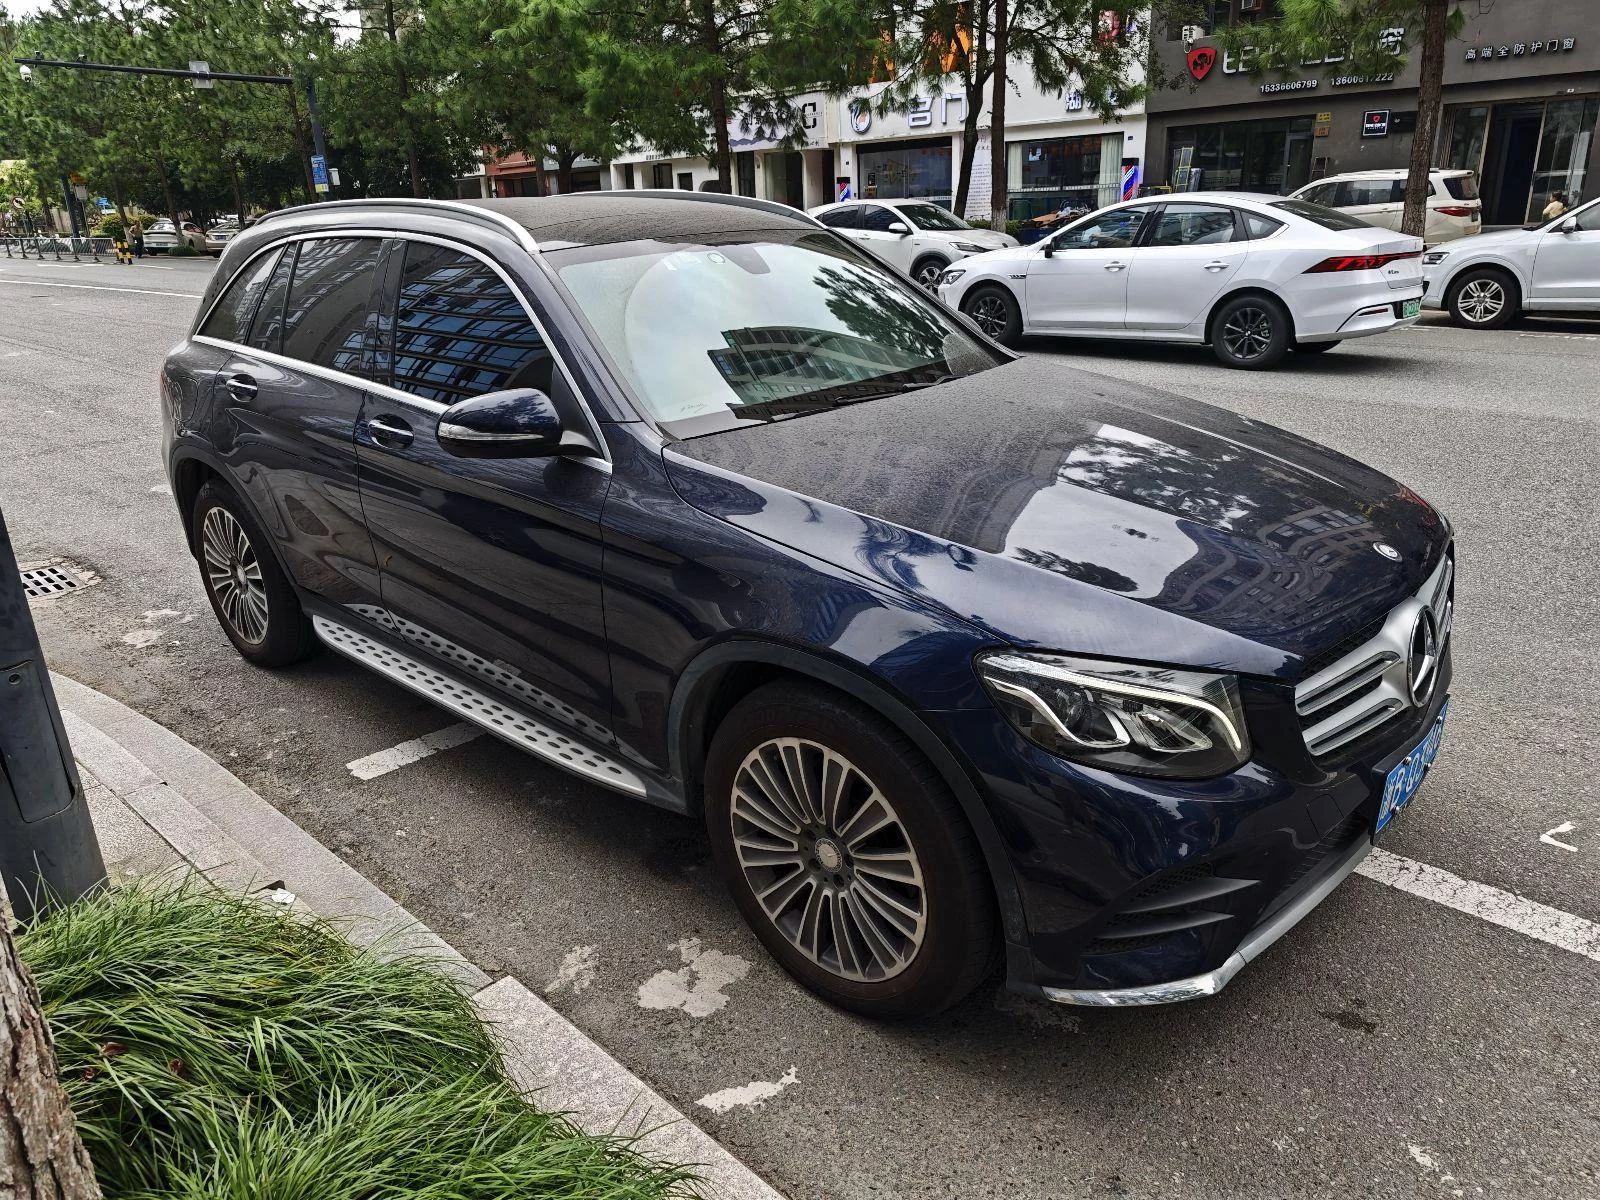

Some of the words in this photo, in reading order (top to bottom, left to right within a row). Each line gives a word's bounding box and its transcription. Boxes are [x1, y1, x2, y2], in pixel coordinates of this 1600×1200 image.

[1465, 38, 1574, 60] 高端全防护门窗
[1260, 80, 1318, 93] 15336606799
[1331, 72, 1394, 86] 1360061222
